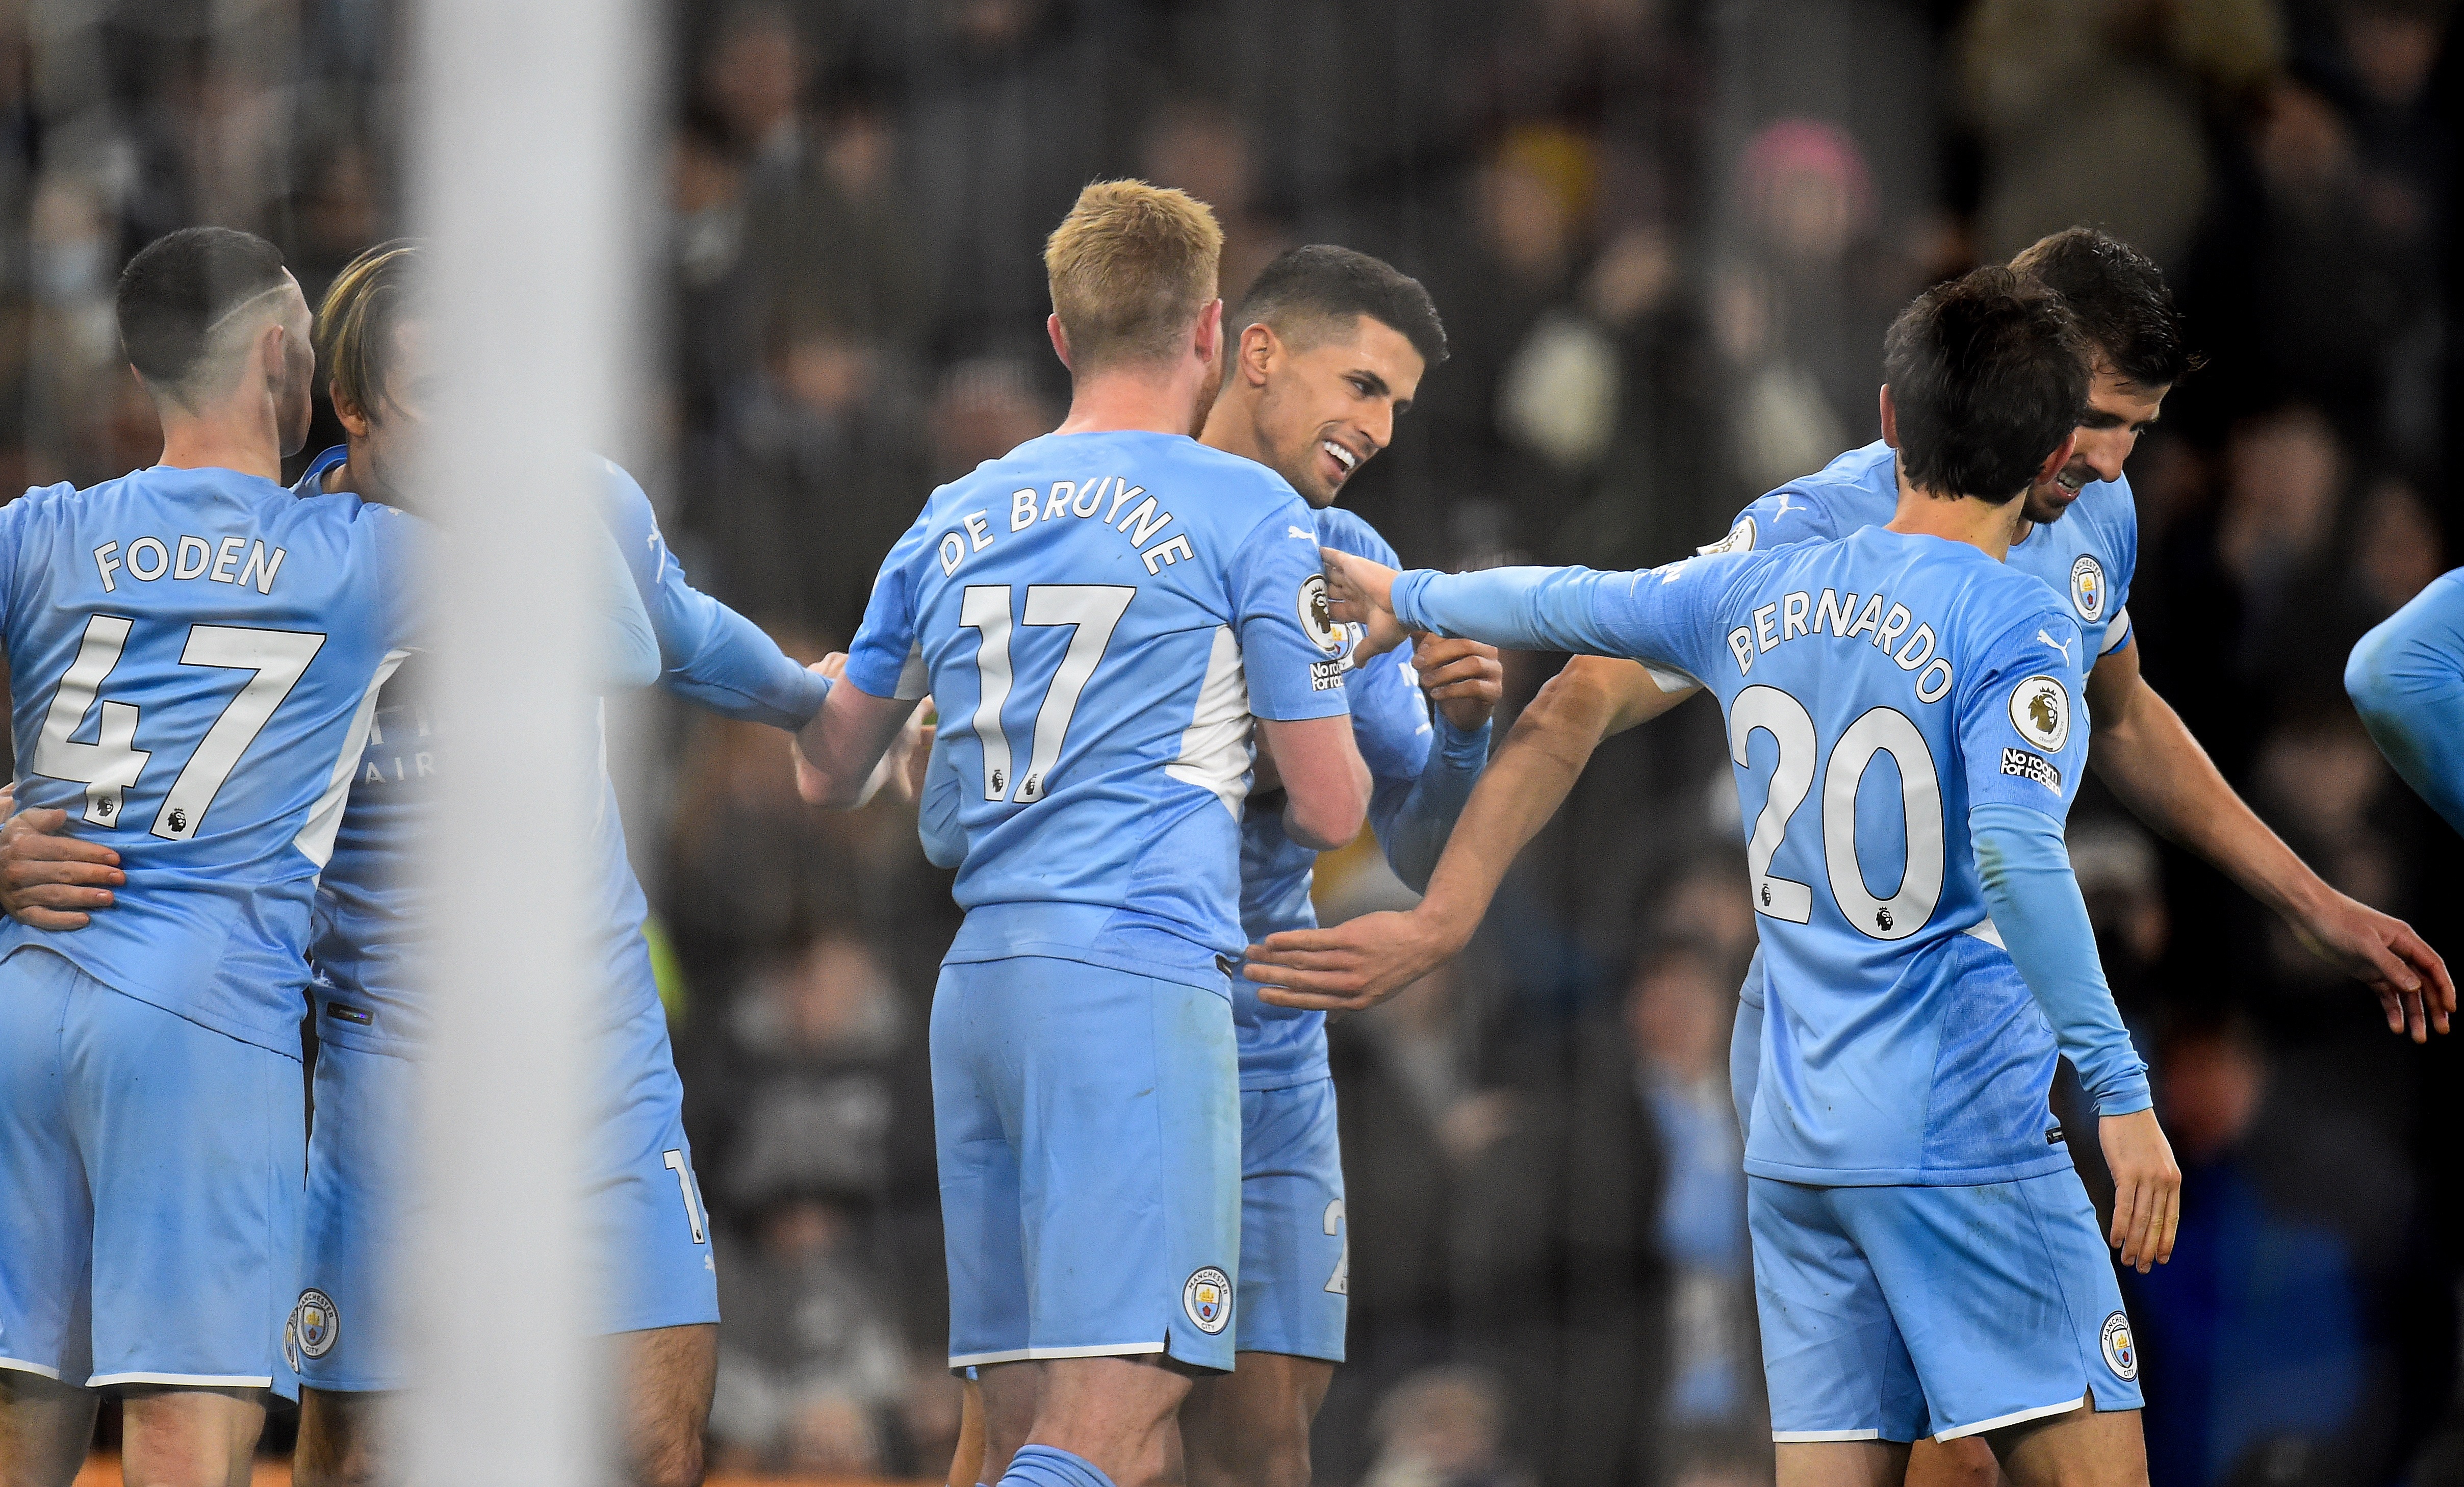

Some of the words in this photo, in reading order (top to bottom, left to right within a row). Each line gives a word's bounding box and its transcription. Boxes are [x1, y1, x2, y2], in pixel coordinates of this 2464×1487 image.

[938, 508, 994, 578] DE
[1010, 476, 1194, 576] BRUYNE
[94, 535, 287, 595] FODEN
[2072, 560, 2100, 582] MANCHESTER
[1728, 588, 1953, 703] BERNARDO
[1310, 663, 1329, 678] No
[1312, 676, 1329, 691] for
[959, 584, 1137, 804] 17
[32, 614, 327, 841] 47
[2000, 760, 2026, 775] for
[2025, 765, 2062, 798] racism
[2002, 748, 2026, 764] No
[2028, 756, 2058, 783] room
[1730, 685, 1945, 941] 20
[1189, 1271, 1228, 1295] MANCHESTER
[299, 1293, 333, 1318] MANCHESTER
